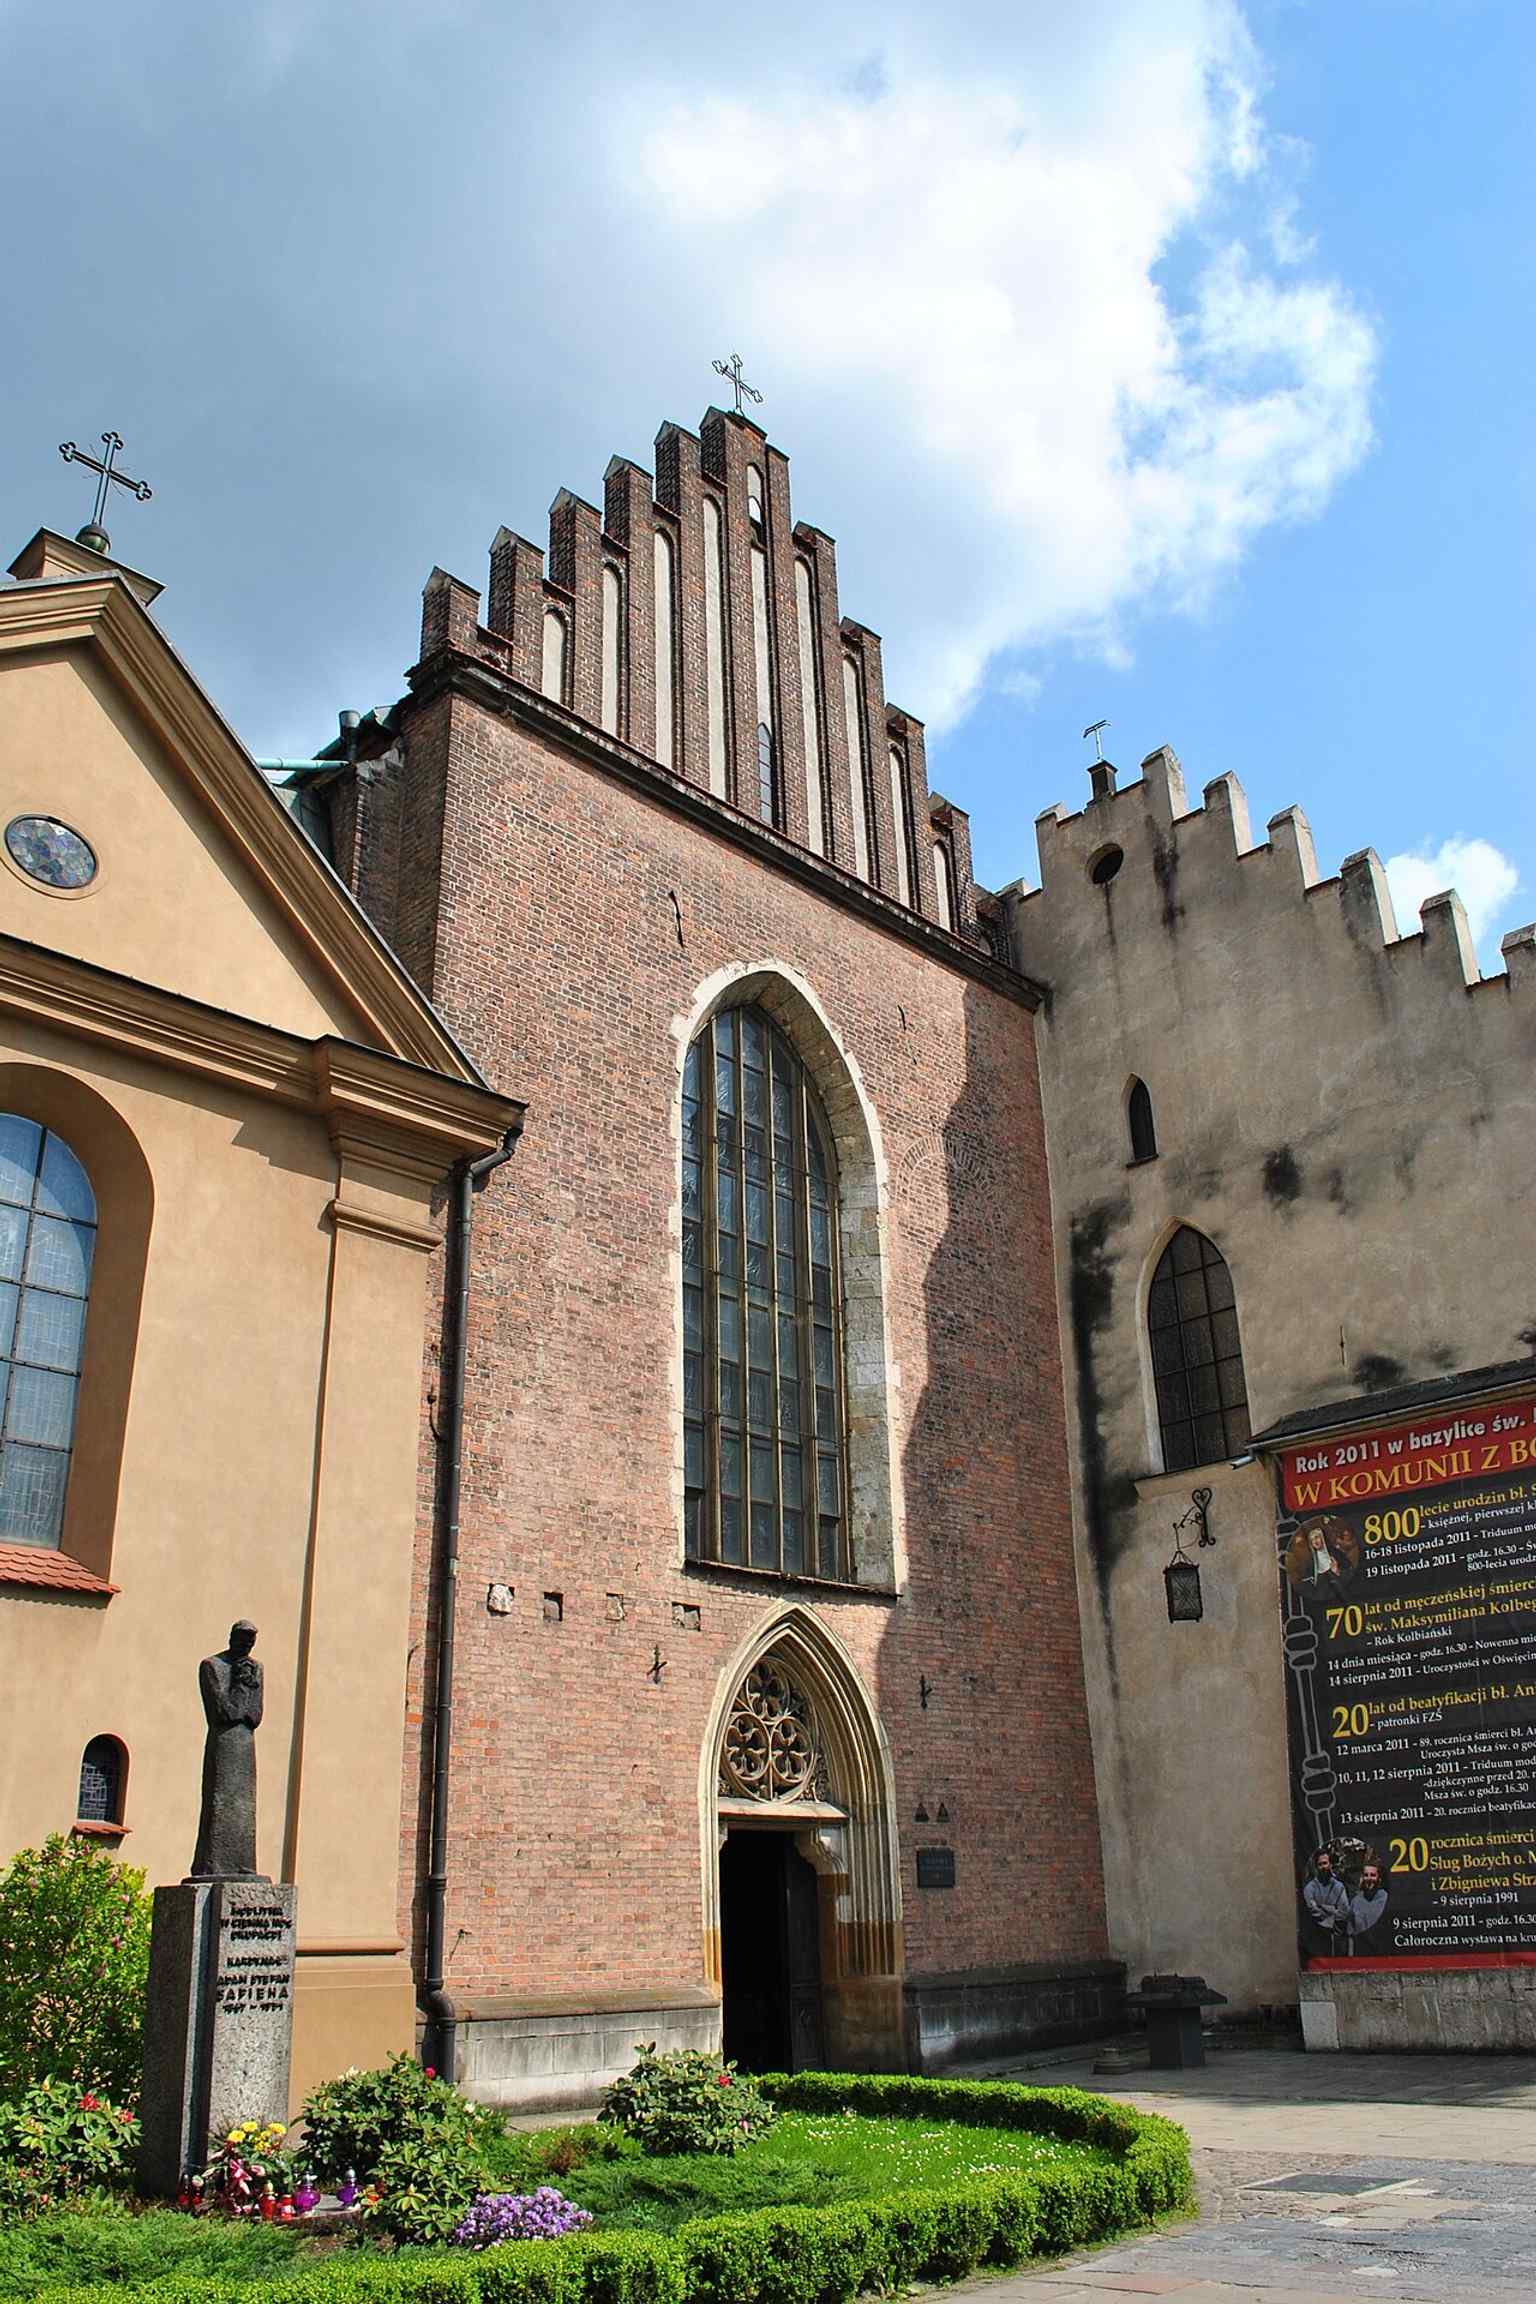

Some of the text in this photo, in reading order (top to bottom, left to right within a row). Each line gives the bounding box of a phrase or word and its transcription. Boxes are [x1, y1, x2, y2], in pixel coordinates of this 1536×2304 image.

[1295, 1452, 1329, 1474] Rok
[1335, 1440, 1379, 1466] 2011
[1387, 1439, 1403, 1455] w
[1409, 1420, 1486, 1450] bazylice
[1491, 1415, 1526, 1432] św.
[1293, 1481, 1322, 1506] W
[1328, 1449, 1472, 1501] KOMUNII
[1480, 1445, 1500, 1470] Z
[1364, 1507, 1420, 1545] 800
[1420, 1502, 1450, 1517] lecie
[1453, 1491, 1506, 1510] urodzin
[1509, 1486, 1528, 1500] bł.
[1474, 1502, 1524, 1523] pierwszej
[1364, 1545, 1392, 1560] 16-18
[1394, 1537, 1444, 1555] listopada
[1446, 1531, 1471, 1545] 2011
[1480, 1526, 1522, 1539] Triduum
[1366, 1566, 1378, 1578] 19
[1380, 1558, 1430, 1576] listopada
[1432, 1552, 1457, 1567] 2011
[1466, 1548, 1492, 1563] godz.
[1493, 1544, 1517, 1557] 16.30
[1467, 1560, 1508, 1572] 800-lecia
[1326, 1578, 1536, 1639] 70 lat od męczeńskiej śmierc
[1365, 1622, 1387, 1634] św.
[1391, 1606, 1486, 1630] Maksymiliana
[1375, 1635, 1395, 1646] Rok
[1396, 1625, 1452, 1642] Kolbiański
[1328, 1660, 1339, 1671] 14
[1341, 1656, 1365, 1668] dnia
[1366, 1651, 1411, 1665] miesiąca
[1420, 1647, 1444, 1661] godz.
[1475, 1638, 1519, 1650] Nowenna
[1328, 1675, 1340, 1686] 14
[1342, 1670, 1387, 1686] sierpnia
[1388, 1666, 1413, 1679] 2011
[1422, 1658, 1480, 1674] Uroczystości
[1332, 1704, 1369, 1738] 20
[1369, 1702, 1385, 1714] lat
[1389, 1698, 1405, 1712] od
[1409, 1688, 1487, 1710] beatyfikacji
[1490, 1685, 1510, 1699] bł.
[1377, 1714, 1420, 1730] patronki
[1336, 1744, 1349, 1756] 12
[1351, 1743, 1383, 1753] marca
[1385, 1738, 1409, 1751] 2011
[1434, 1733, 1472, 1745] rocznica
[1474, 1728, 1509, 1740] śmierci
[1420, 1747, 1465, 1760] Uroczysta
[1467, 1744, 1492, 1754] Msza
[1494, 1741, 1511, 1751] św.
[1512, 1742, 1519, 1750] o
[1339, 1772, 1353, 1784] 10,
[1355, 1770, 1370, 1783] 11,
[1373, 1768, 1385, 1780] 12
[1387, 1764, 1433, 1780] sierpnia
[1435, 1761, 1460, 1774] 2011
[1470, 1759, 1513, 1771] Triduum
[1486, 1770, 1514, 1784] przed
[1516, 1769, 1530, 1780] 20.
[1424, 1791, 1449, 1800] Msza
[1450, 1789, 1467, 1799] św.
[1468, 1789, 1475, 1797] o
[1477, 1785, 1503, 1799] godz.
[1340, 1812, 1352, 1824] 13
[1354, 1809, 1398, 1825] sierpnia
[1400, 1807, 1424, 1819] 2011
[1433, 1806, 1447, 1817] 20.
[1448, 1803, 1486, 1816] rocznica
[1389, 1828, 1535, 1873] 20 rocznica śmierci
[1430, 1856, 1461, 1873] Sług
[1463, 1852, 1511, 1871] Bożych
[1514, 1856, 1525, 1865] o.
[1431, 1877, 1437, 1891] i
[1439, 1875, 1510, 1893] Zbigniewa
[1440, 1895, 1447, 1905] 9
[1449, 1893, 1492, 1908] sierpnia
[1495, 1892, 1519, 1904] 1991
[1393, 1918, 1400, 1929] 9
[1402, 1916, 1449, 1932] sierpnia
[1450, 1914, 1476, 1927] 2011
[1486, 1915, 1512, 1928] godz.
[1394, 1934, 1459, 1947] Całoroczna
[1461, 1935, 1503, 1947] wystawa
[1505, 1935, 1518, 1943] na
[250, 1974, 290, 1985] STEFAN
[216, 1987, 289, 2001] SAPIEHA
